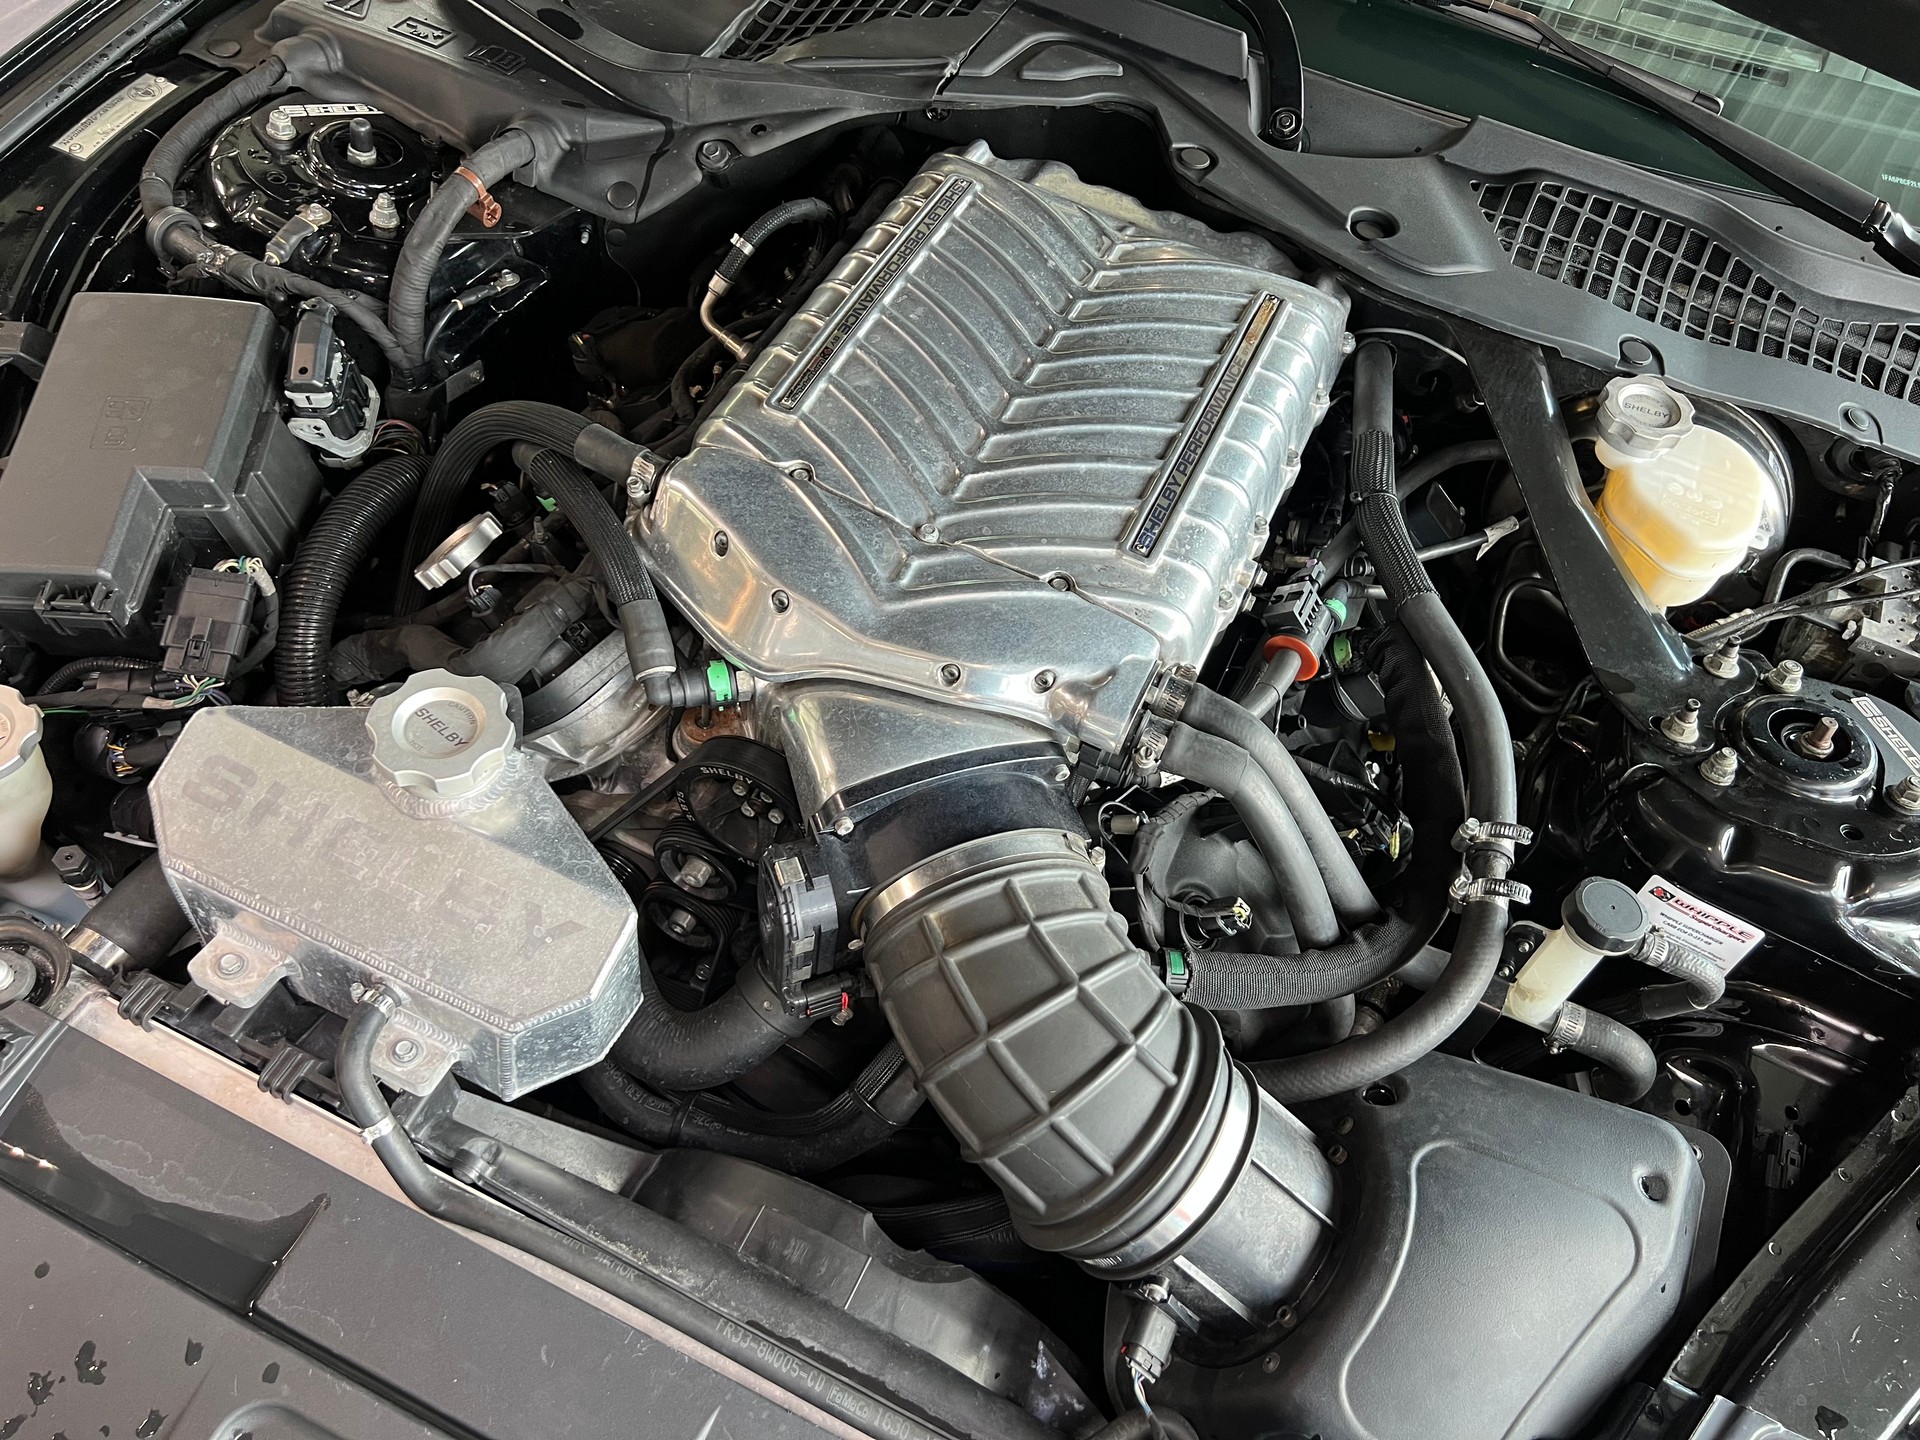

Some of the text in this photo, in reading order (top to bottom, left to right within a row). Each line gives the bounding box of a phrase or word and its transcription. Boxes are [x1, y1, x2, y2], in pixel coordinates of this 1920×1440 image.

[61, 96, 124, 145] SHELBY AMERICAN
[922, 183, 966, 232] SHELBY
[836, 229, 927, 335] PERFORMANCE
[1623, 402, 1669, 419] SHELBY
[1137, 473, 1182, 549] SHELBY
[1176, 357, 1247, 477] PERFORMANCE
[414, 707, 470, 747] SHELBY
[448, 701, 478, 725] CAUTION
[409, 740, 424, 751] HOT
[700, 766, 753, 785] SHELBY
[181, 754, 588, 961] SHELBY
[1660, 912, 1683, 926] WHIPPLE
[1674, 898, 1755, 940] WHIPPLE
[1690, 914, 1746, 944] Superchargers
[829, 1385, 871, 1420] FoMoCo
[873, 1406, 911, 1440] 1630
